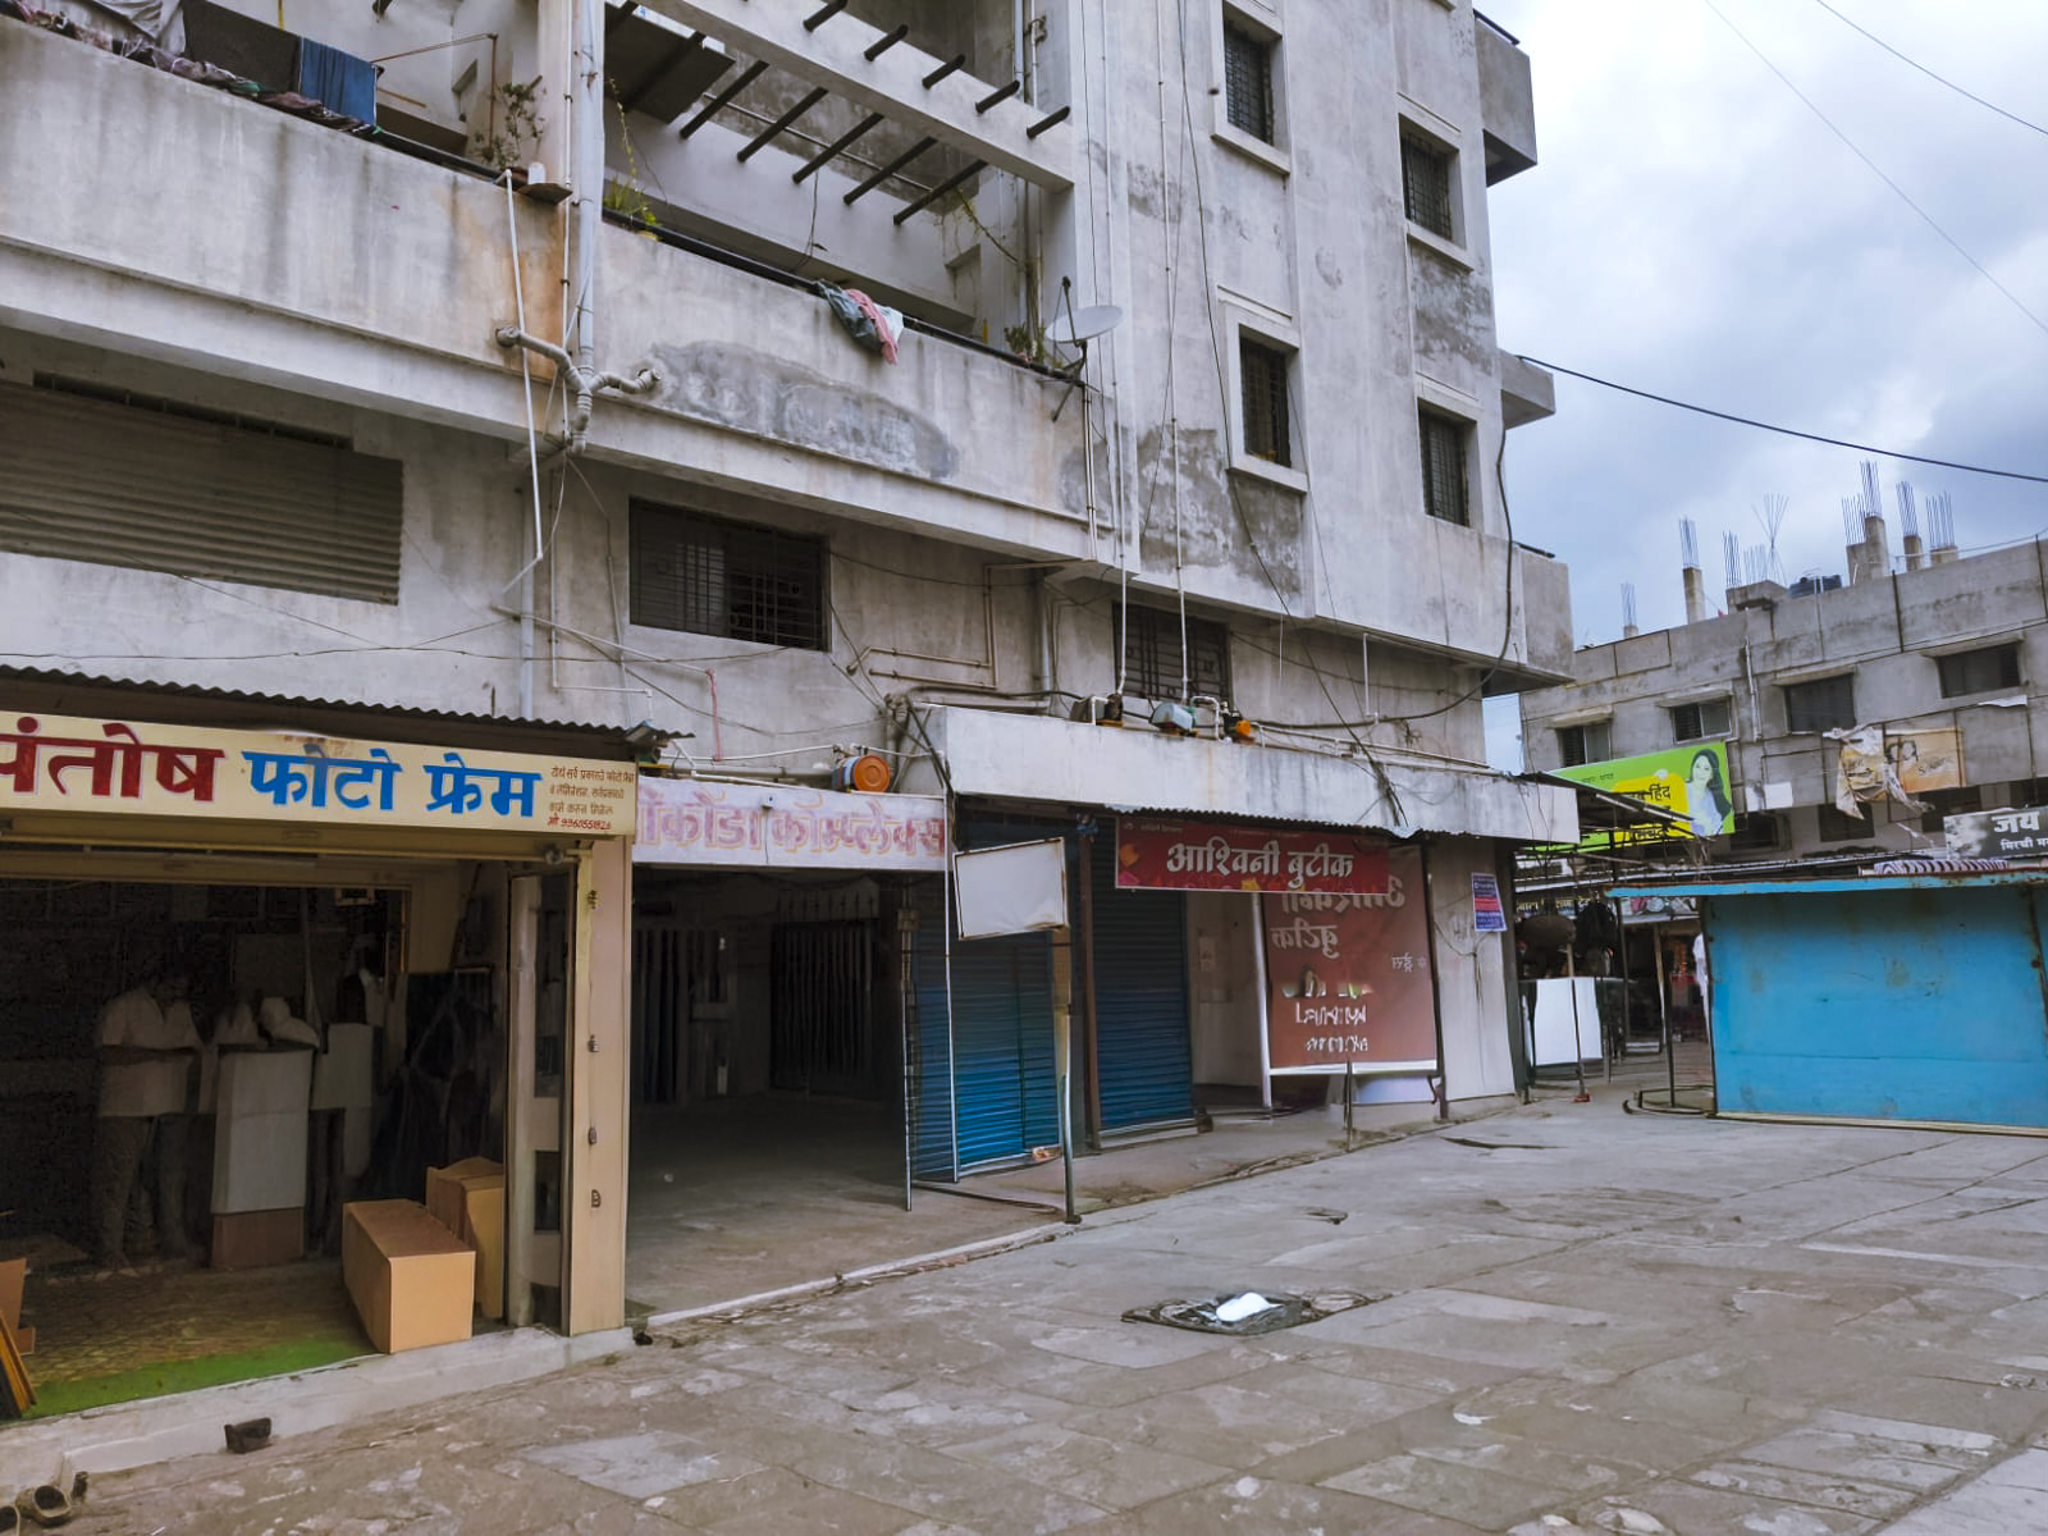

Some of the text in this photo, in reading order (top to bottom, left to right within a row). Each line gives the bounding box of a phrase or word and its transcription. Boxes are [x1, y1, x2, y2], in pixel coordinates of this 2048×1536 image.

[242, 743, 402, 812] फोटो
[423, 752, 543, 818] फ्रेम
[1991, 811, 2040, 833] जय
[1287, 842, 1355, 889] बुटीक
